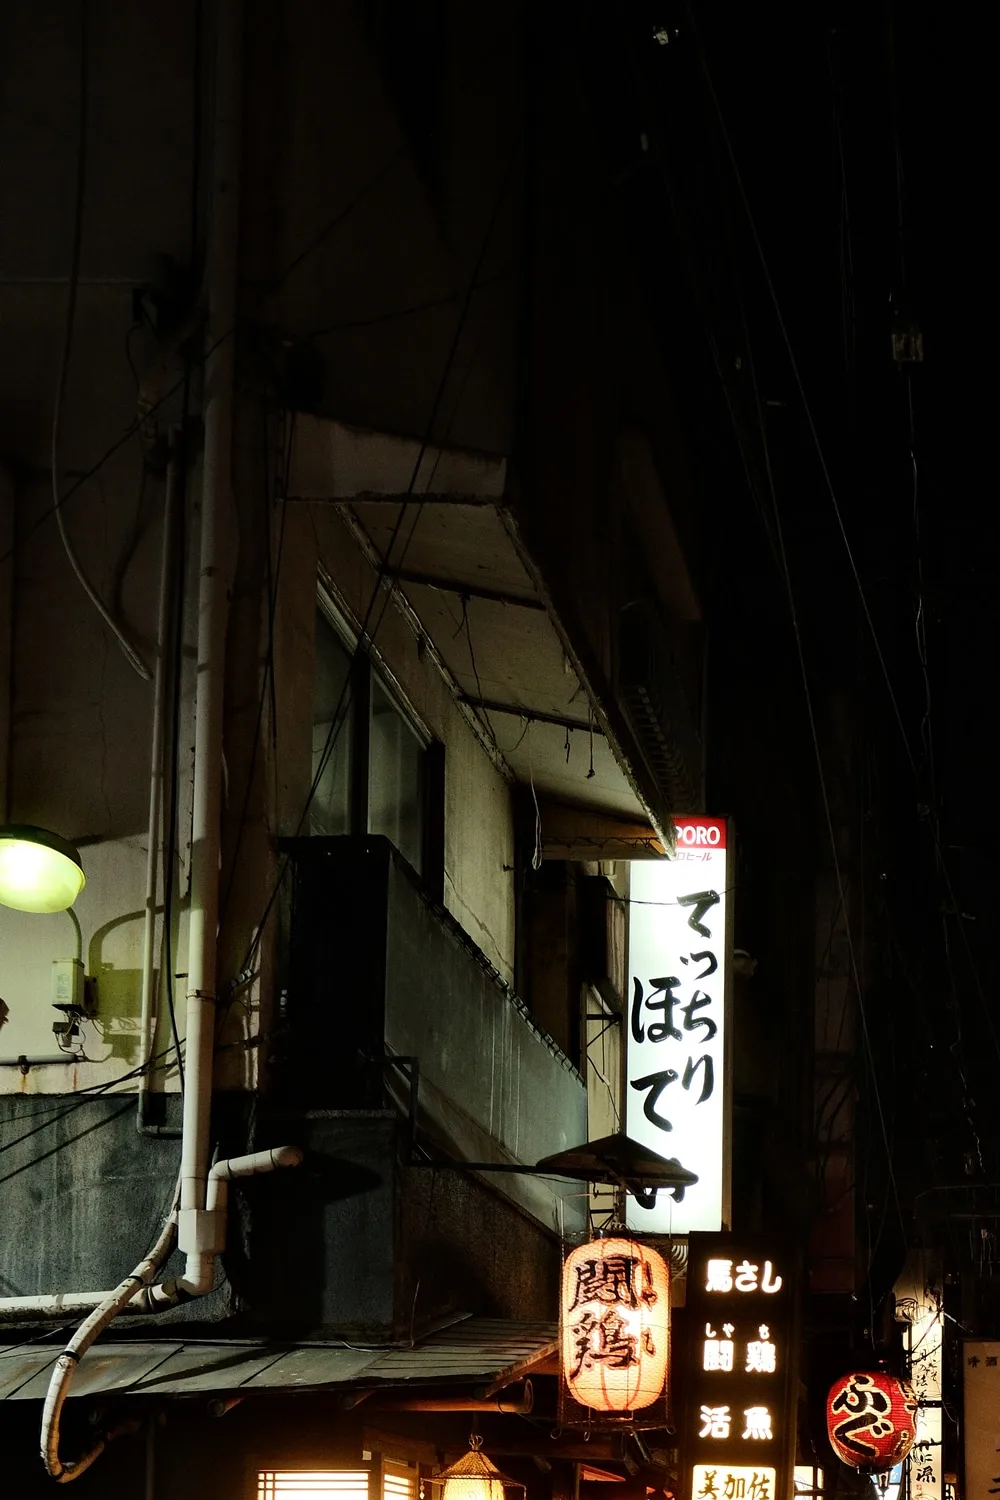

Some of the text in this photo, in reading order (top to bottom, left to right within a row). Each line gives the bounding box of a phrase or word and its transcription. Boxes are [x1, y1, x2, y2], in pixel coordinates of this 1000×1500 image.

[676, 889, 720, 1106] てっちり
[706, 1259, 783, 1294] 馬さし
[703, 1339, 777, 1373] 闘鶏
[699, 1404, 773, 1440] 活魚
[832, 1374, 894, 1457] ふぐ
[697, 1470, 771, 1500] 美加佐
